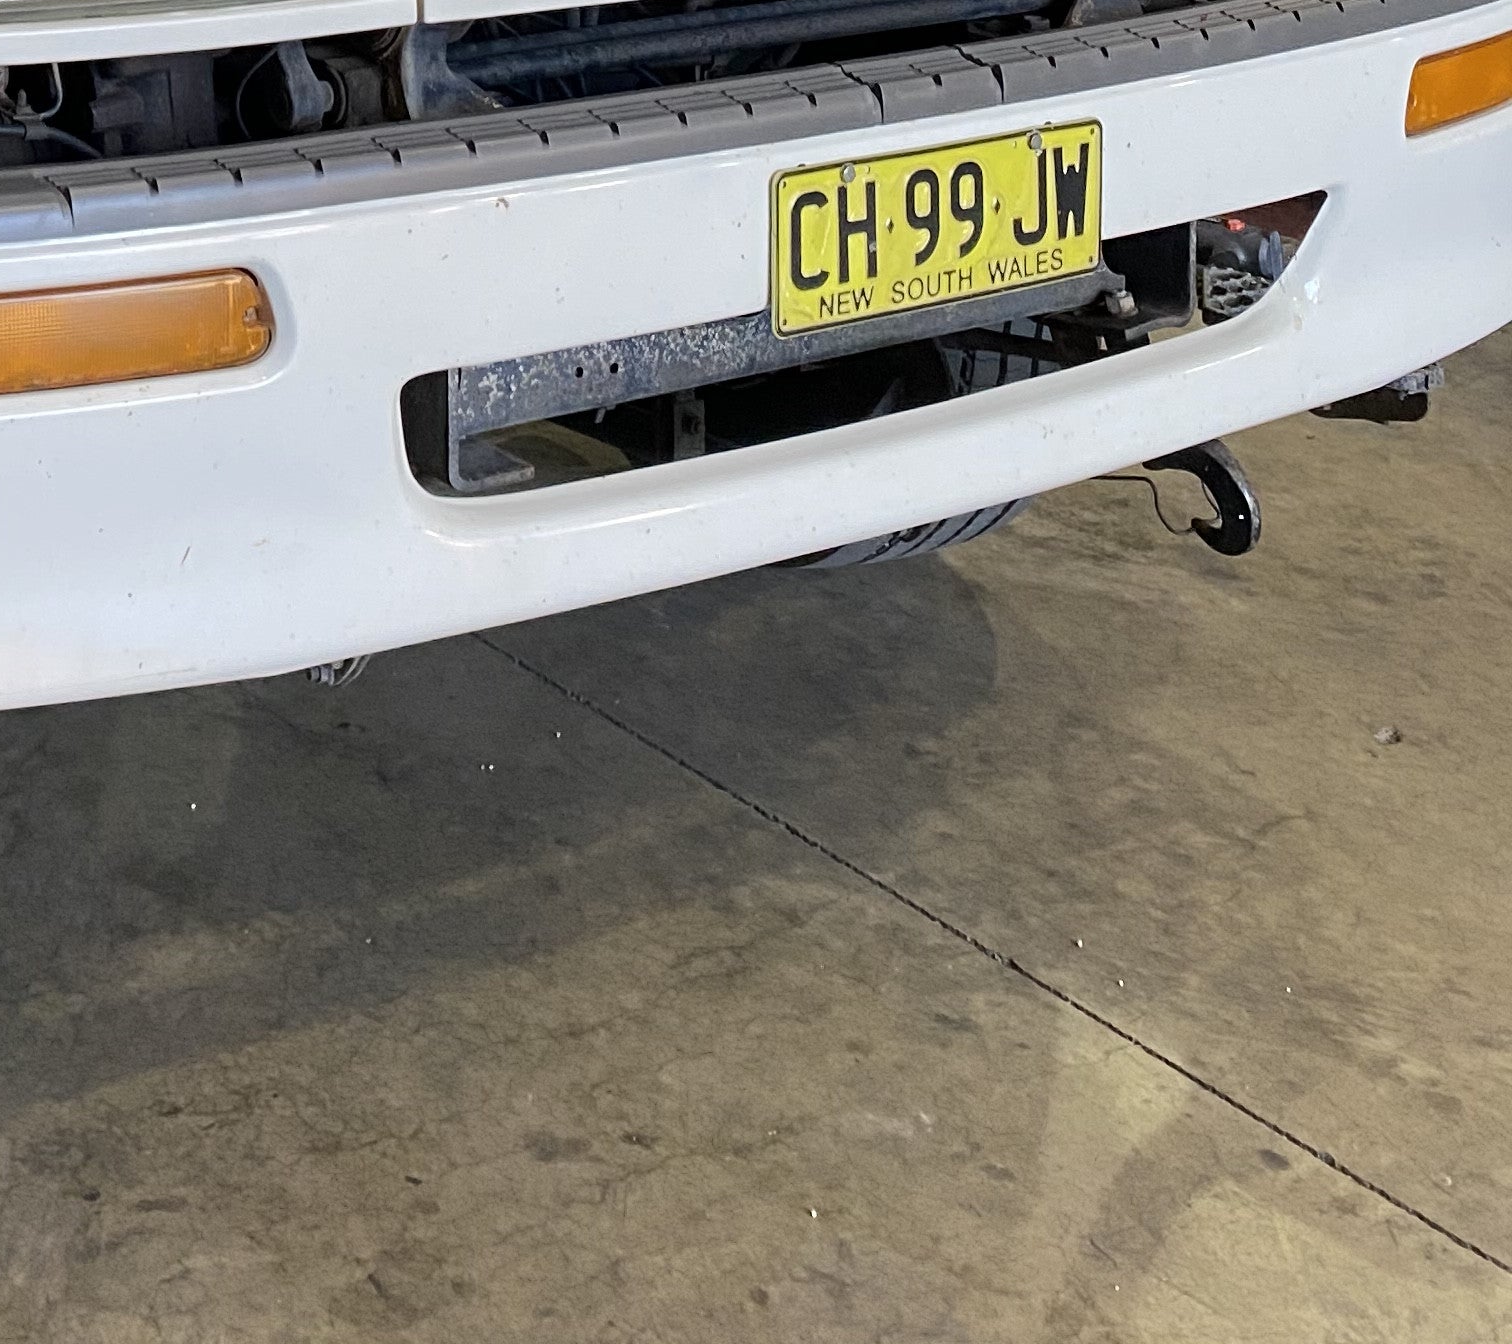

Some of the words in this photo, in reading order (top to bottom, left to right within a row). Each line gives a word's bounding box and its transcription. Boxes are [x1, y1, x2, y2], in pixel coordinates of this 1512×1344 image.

[819, 286, 874, 318] NEW
[892, 266, 973, 304] SOUTH
[987, 248, 1064, 284] WALES
